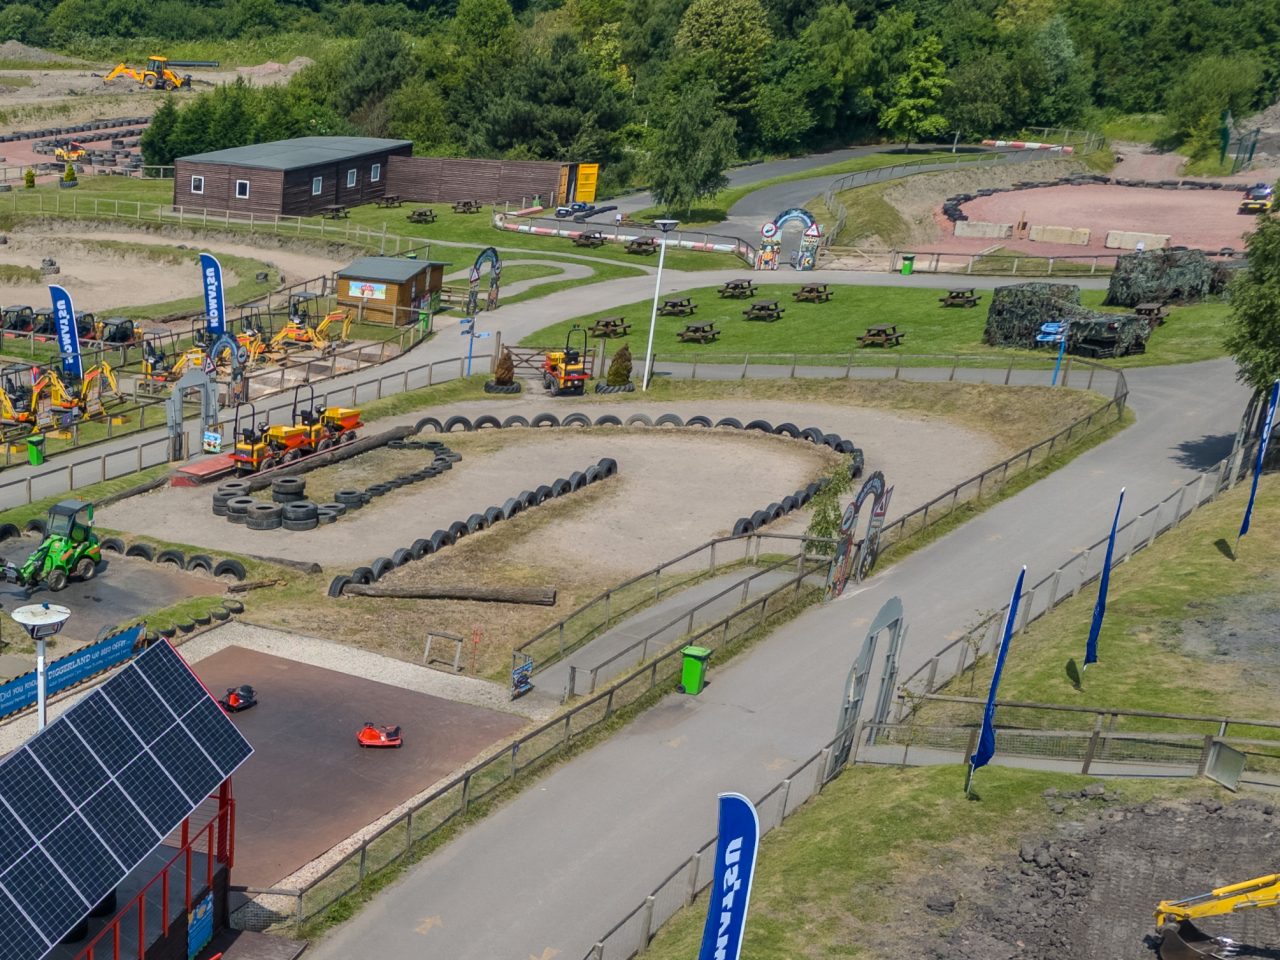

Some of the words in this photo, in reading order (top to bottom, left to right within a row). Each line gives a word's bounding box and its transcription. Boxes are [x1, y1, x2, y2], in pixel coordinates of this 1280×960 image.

[0, 691, 12, 702] Did
[13, 685, 24, 698] you
[48, 654, 91, 680] DIGGERLAND
